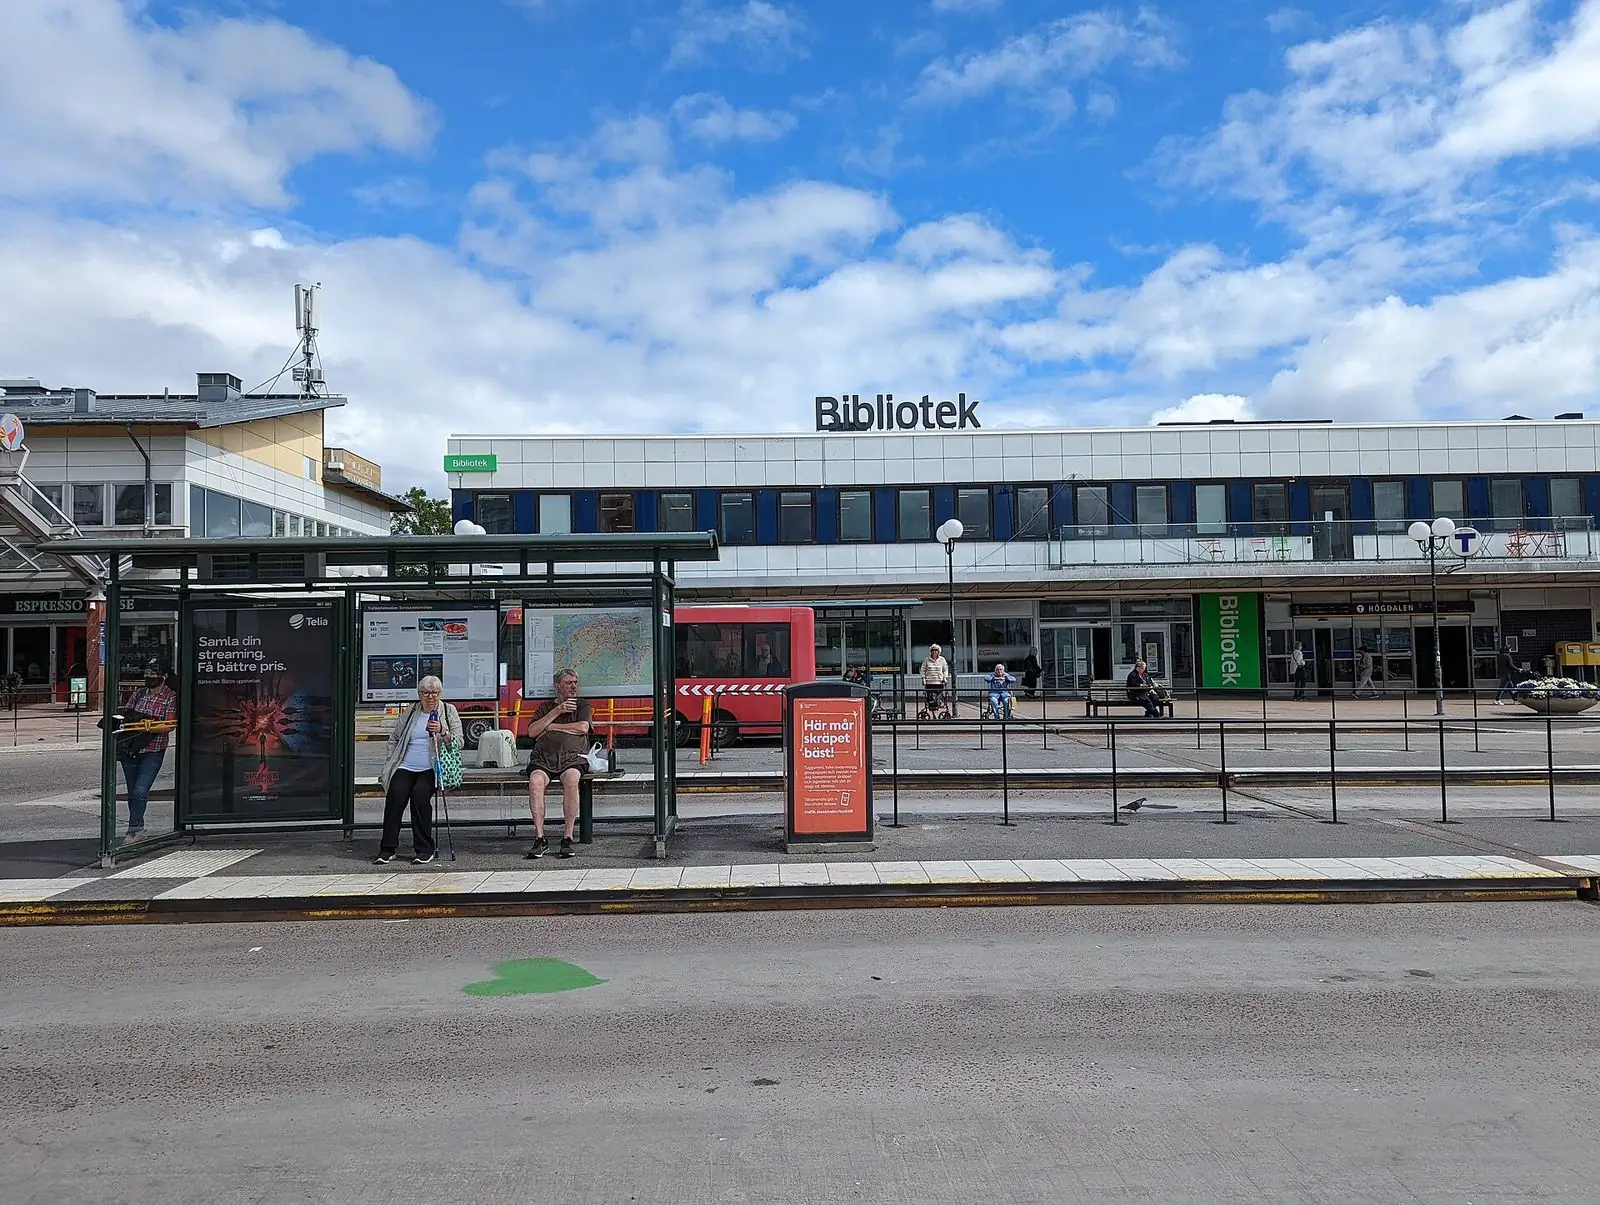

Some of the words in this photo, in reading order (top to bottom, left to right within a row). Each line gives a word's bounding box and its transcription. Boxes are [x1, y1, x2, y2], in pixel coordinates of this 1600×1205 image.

[815, 393, 982, 431] Bibliotek
[452, 459, 488, 467] Bibliotek
[1454, 533, 1477, 553] T
[15, 599, 83, 612] ESPRESSO
[1368, 603, 1414, 612] HÖGDALEN
[305, 616, 328, 627] Telia
[199, 636, 240, 647] Samla
[242, 635, 262, 646] din
[1219, 595, 1241, 685] Bibliotek
[198, 649, 266, 661] streaming.
[198, 661, 213, 672] Få
[216, 661, 257, 672] bättre
[260, 660, 287, 673] pris.
[804, 719, 828, 731] Här
[829, 718, 855, 731] mår
[803, 732, 851, 746] skräpet
[804, 747, 835, 758] bäst!
